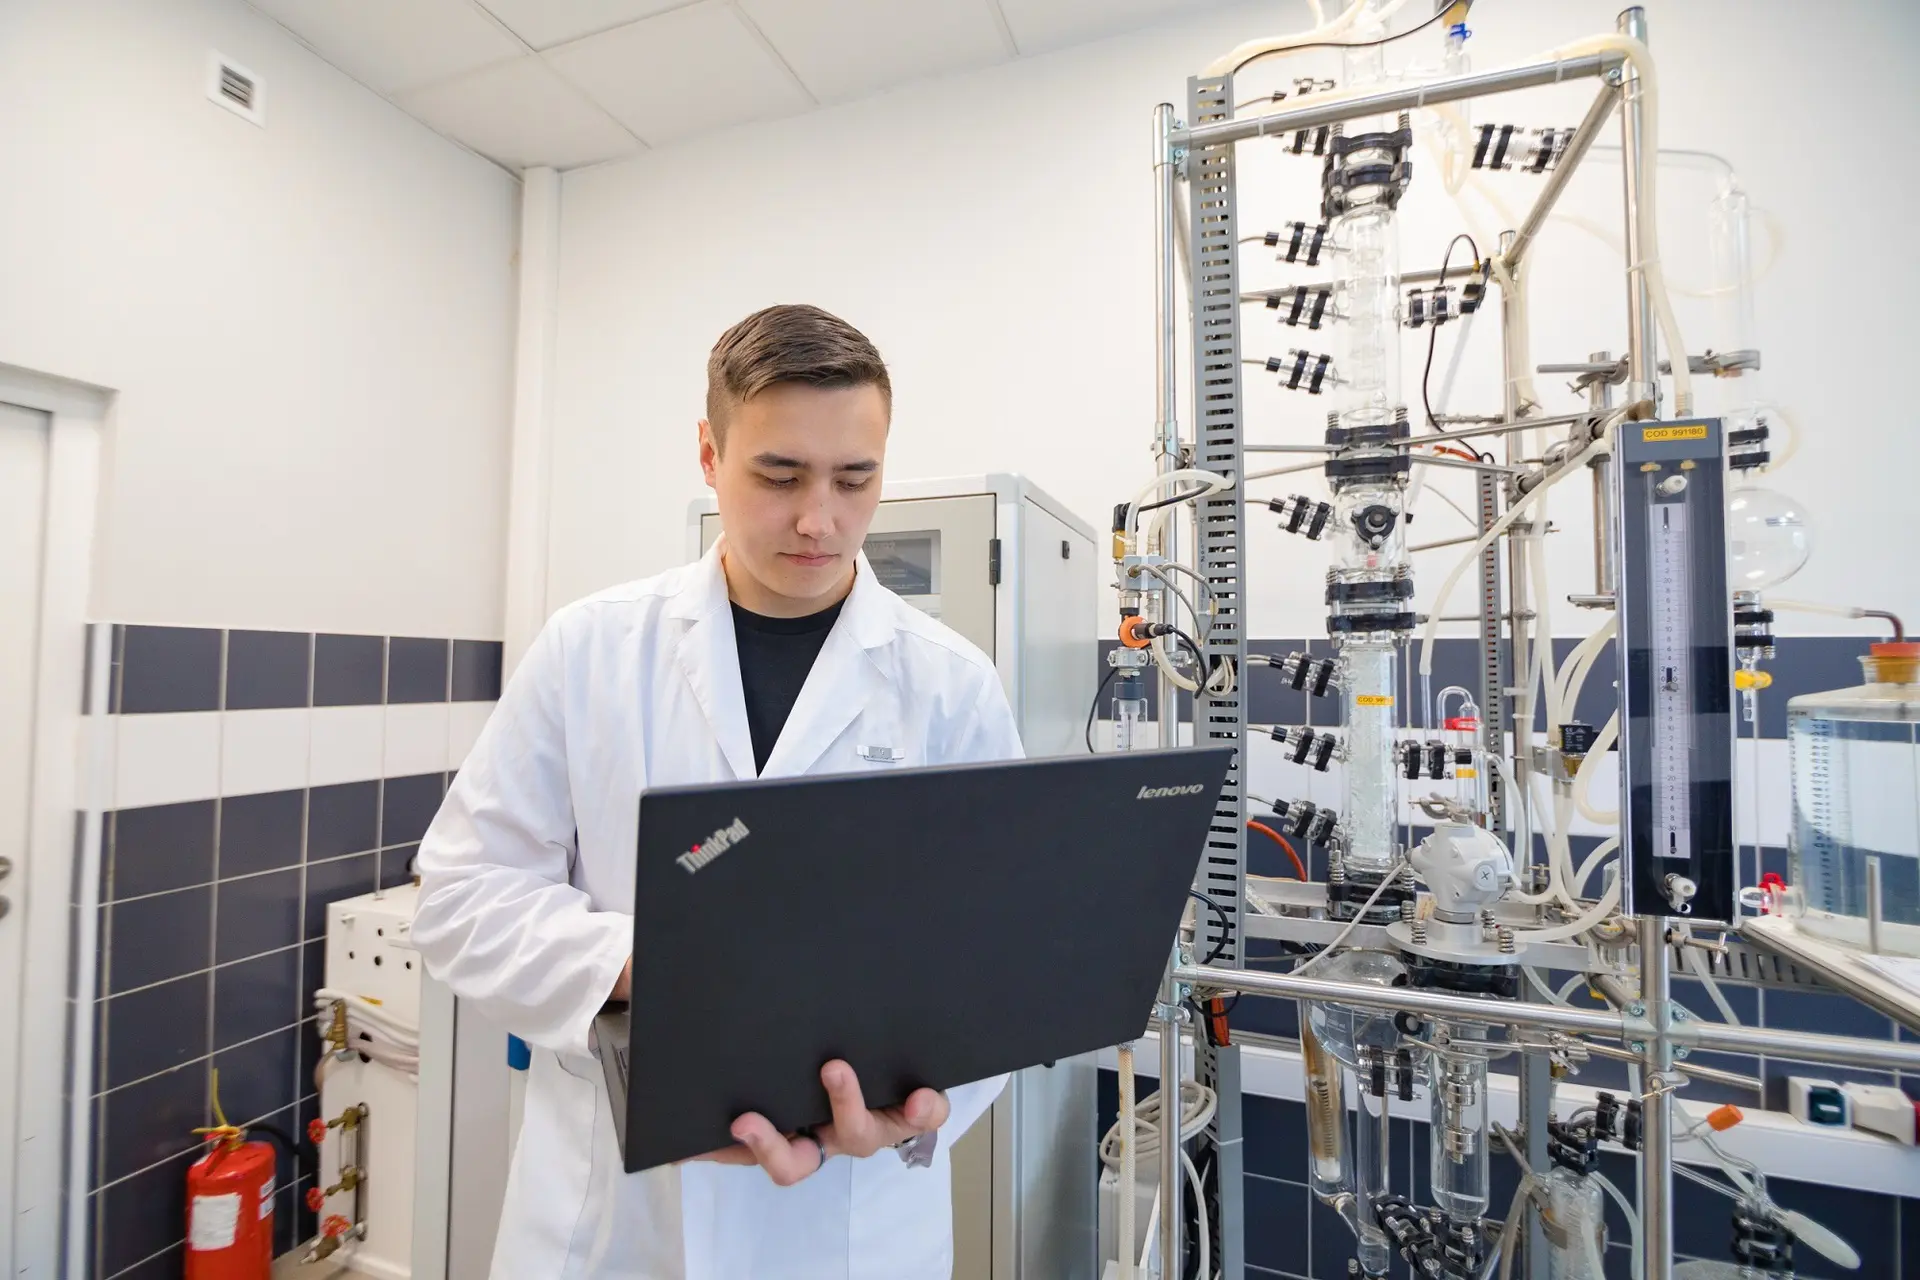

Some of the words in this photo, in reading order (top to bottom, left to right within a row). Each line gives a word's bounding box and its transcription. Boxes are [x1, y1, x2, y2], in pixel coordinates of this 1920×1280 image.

[1645, 429, 1668, 438] COD
[1672, 427, 1703, 436] 991180
[1136, 783, 1204, 800] lenovo
[676, 816, 750, 875] ThinkPad
